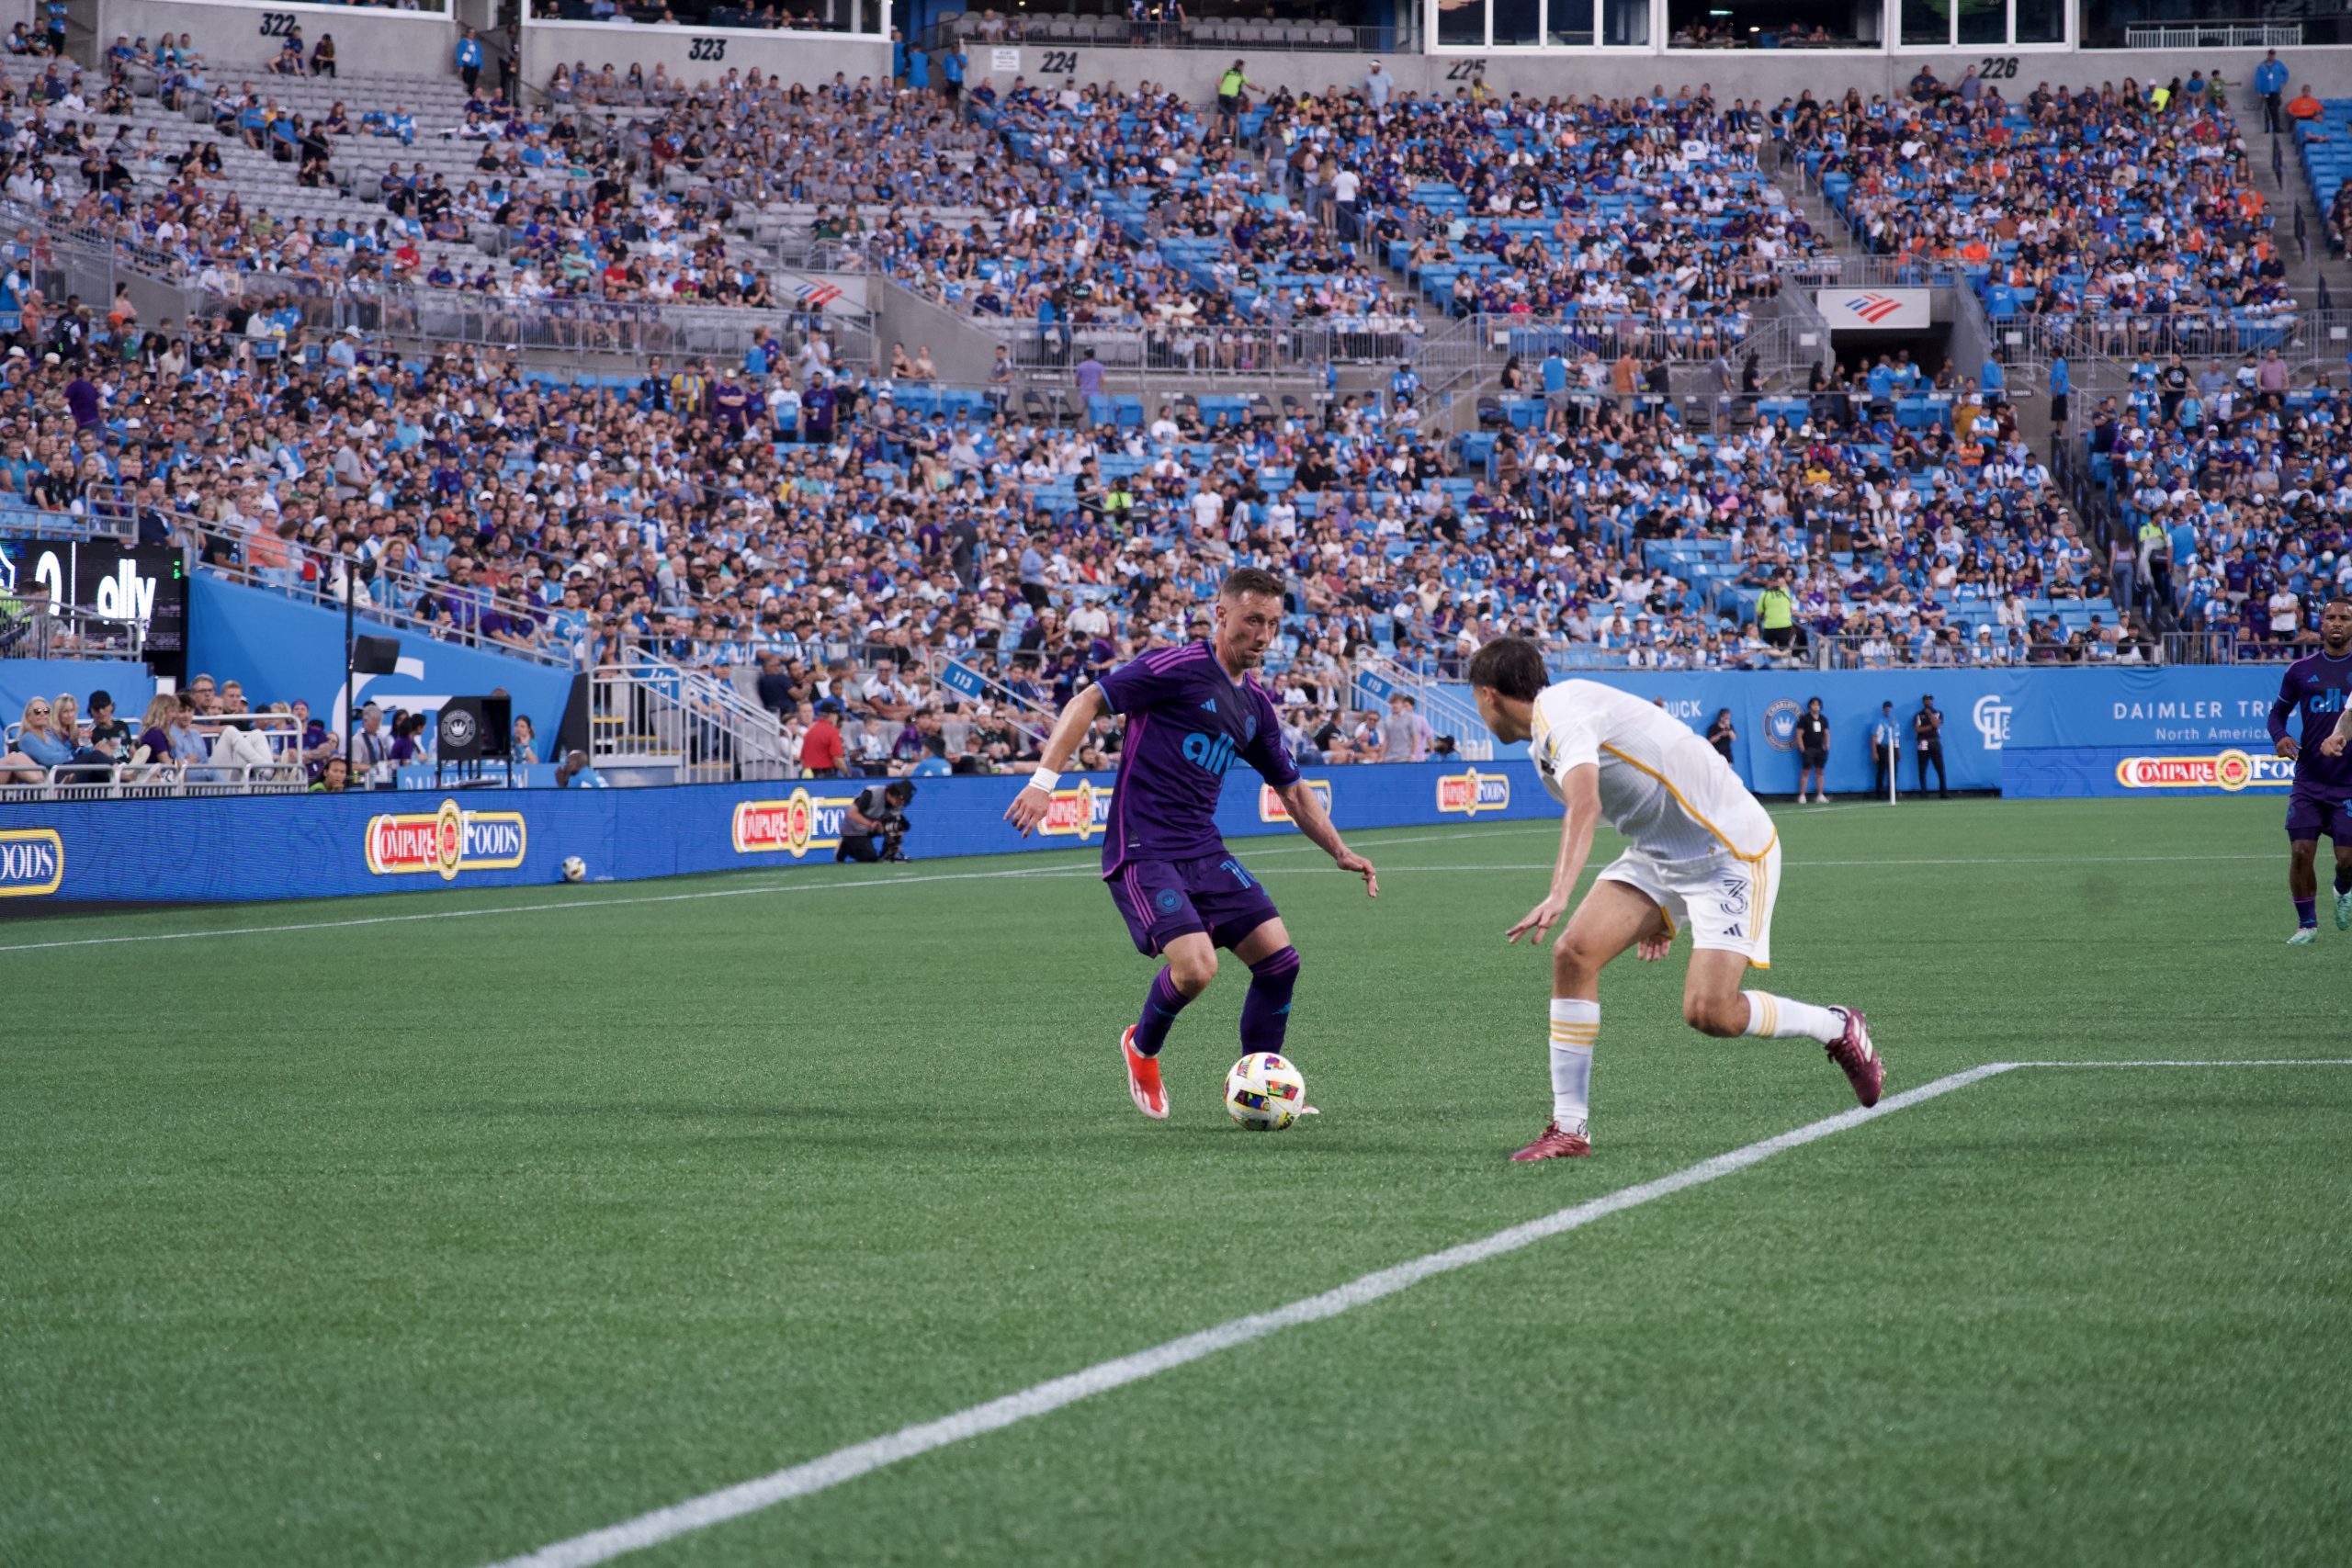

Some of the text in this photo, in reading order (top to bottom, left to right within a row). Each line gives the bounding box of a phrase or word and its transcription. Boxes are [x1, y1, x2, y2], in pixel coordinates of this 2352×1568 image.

[260, 13, 296, 37] 322
[689, 38, 727, 61] 323
[1039, 51, 1078, 73] 224
[1979, 57, 2019, 78] 226
[97, 558, 156, 642] ally
[954, 671, 972, 689] 113
[1664, 700, 1702, 719] RUCK
[2114, 701, 2222, 720] DAIMLER
[2155, 726, 2270, 741] North America
[2127, 757, 2215, 788] COMPARE
[809, 796, 845, 836] FOO
[372, 810, 519, 874] COMPARE FOODS
[1720, 879, 1748, 915] 3
